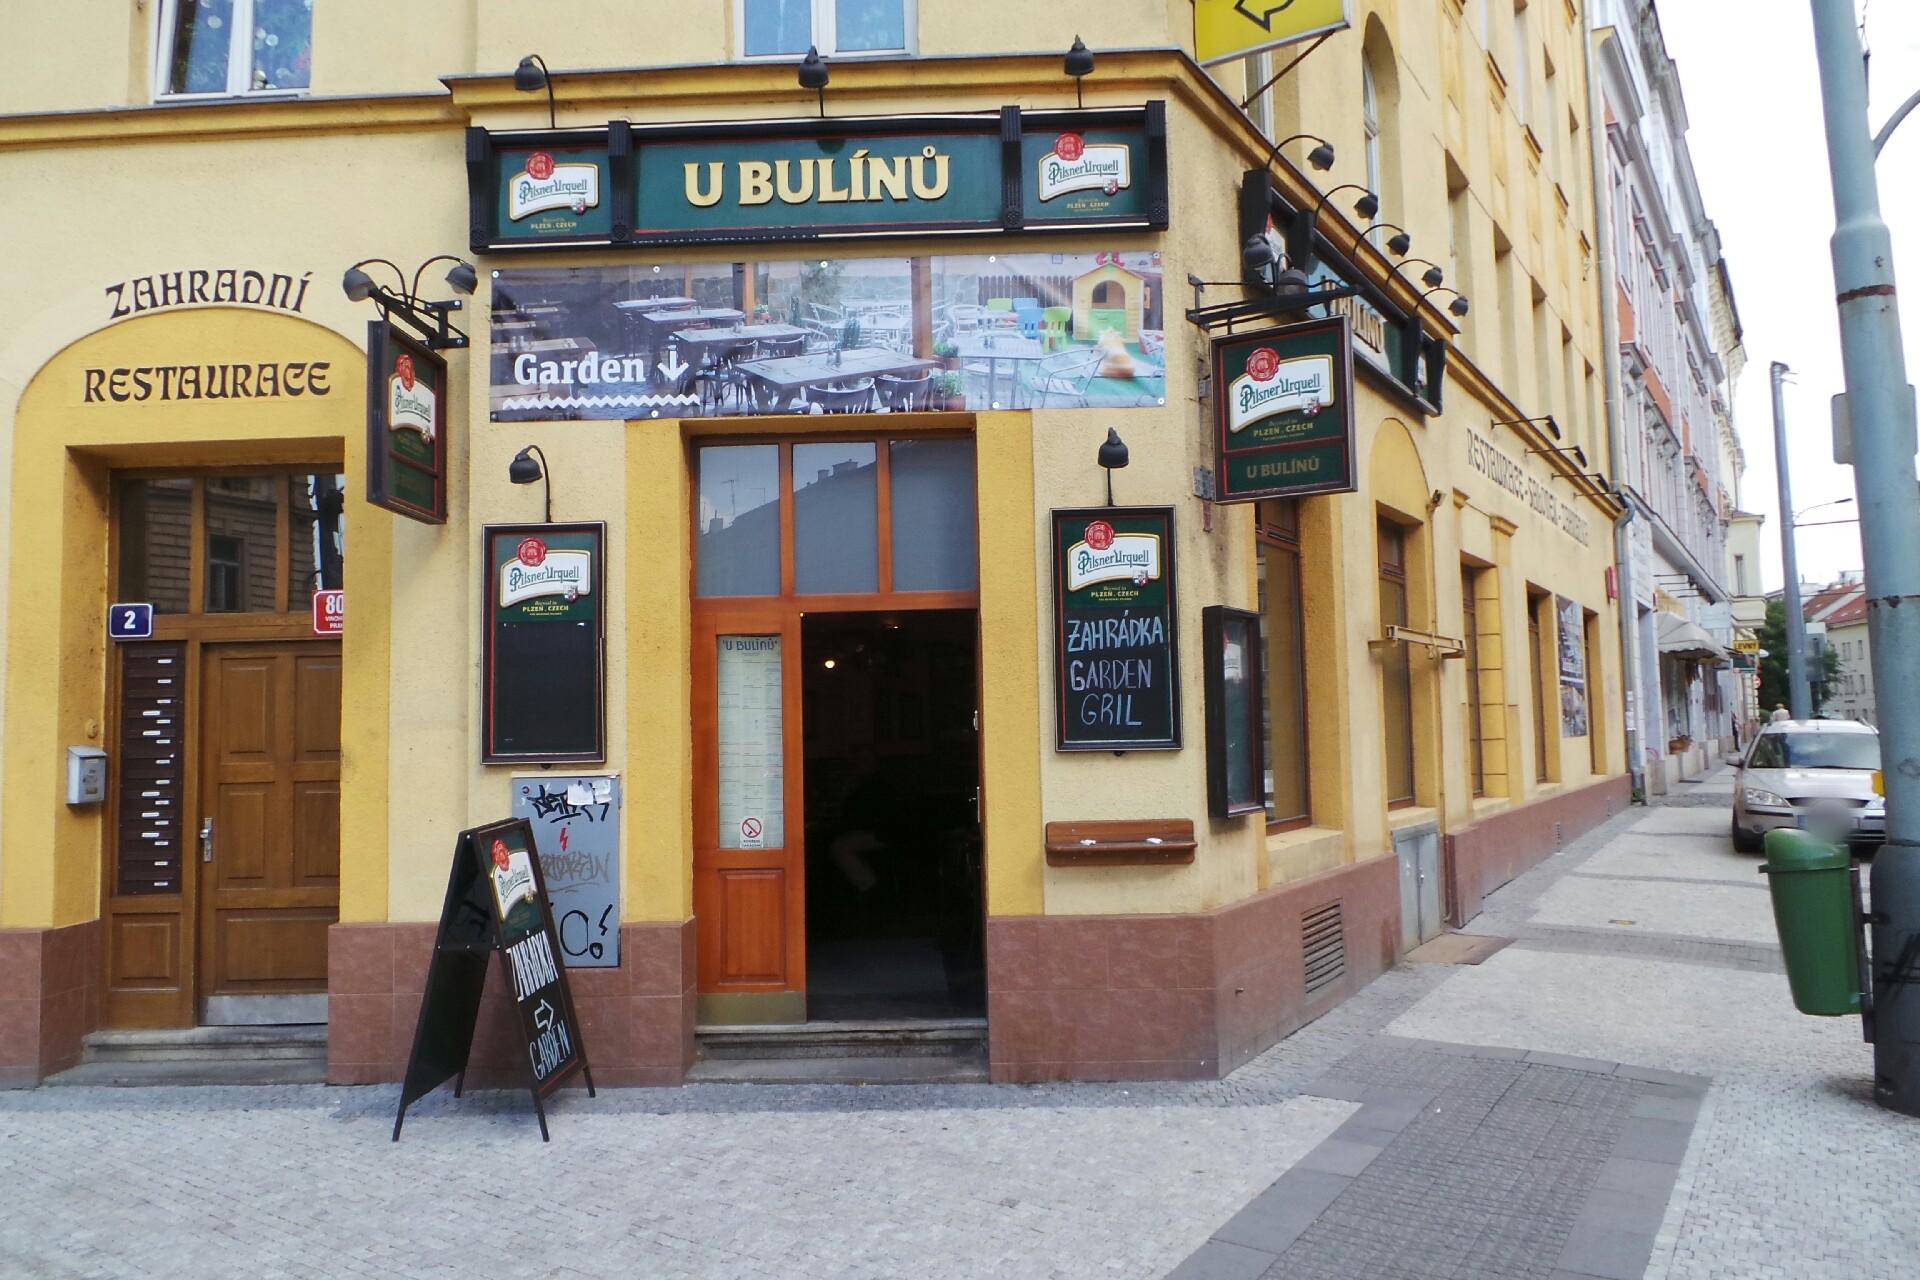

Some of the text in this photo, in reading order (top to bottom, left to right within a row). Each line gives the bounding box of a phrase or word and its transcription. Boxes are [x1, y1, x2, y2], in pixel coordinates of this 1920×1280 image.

[683, 145, 951, 207] U BULÍNŮ
[1048, 159, 1119, 186] Pilsner Urquell
[519, 178, 588, 205] Pilsner Urquell
[105, 269, 314, 319] ZAHRADNÍ
[83, 361, 332, 403] RESTAURACE
[513, 350, 646, 386] Garden
[1239, 372, 1321, 414] Pilsner Urquell
[1246, 464, 1257, 479] U
[509, 564, 580, 592] Pilsner Urquell
[1077, 549, 1149, 576] Pilsner Urquell
[123, 610, 136, 629] 2
[325, 594, 344, 615] 80
[1067, 610, 1164, 653] ZAHRÁDKA
[1069, 658, 1152, 691] GARDEN
[1080, 693, 1143, 726] GRIL
[529, 1019, 571, 1081] GARDEN
